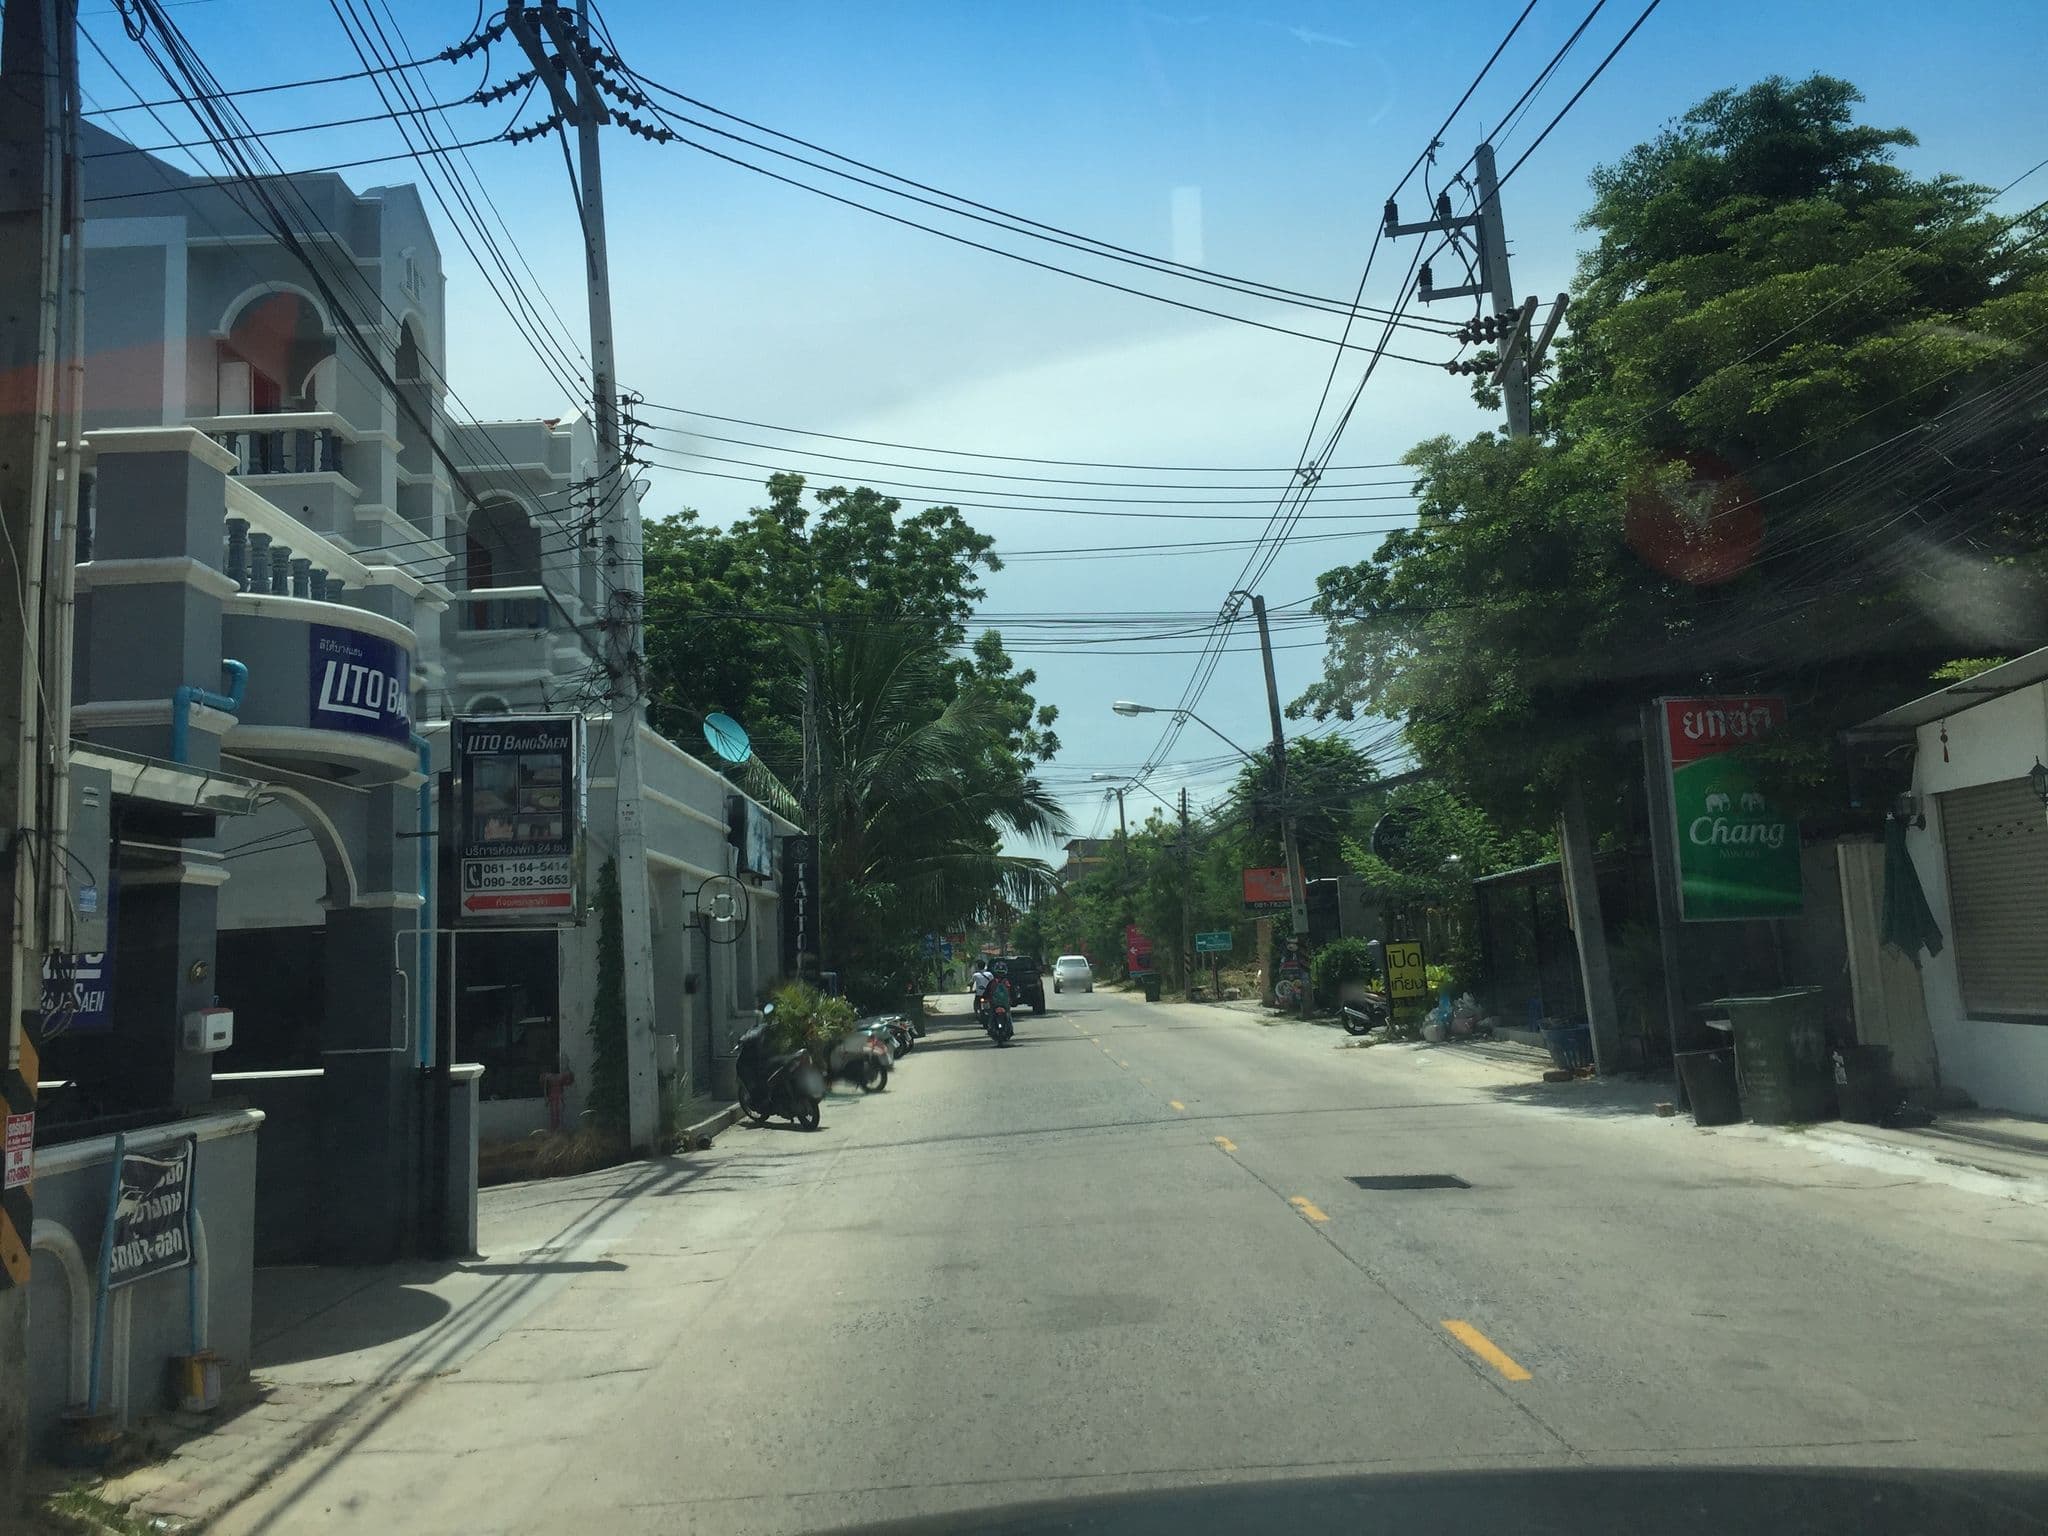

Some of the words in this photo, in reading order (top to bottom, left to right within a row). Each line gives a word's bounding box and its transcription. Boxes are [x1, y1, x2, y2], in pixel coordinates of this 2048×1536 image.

[318, 660, 384, 720] LITO
[466, 734, 501, 754] LITO
[1689, 816, 1785, 849] Chang
[1388, 948, 1421, 969] เปิด
